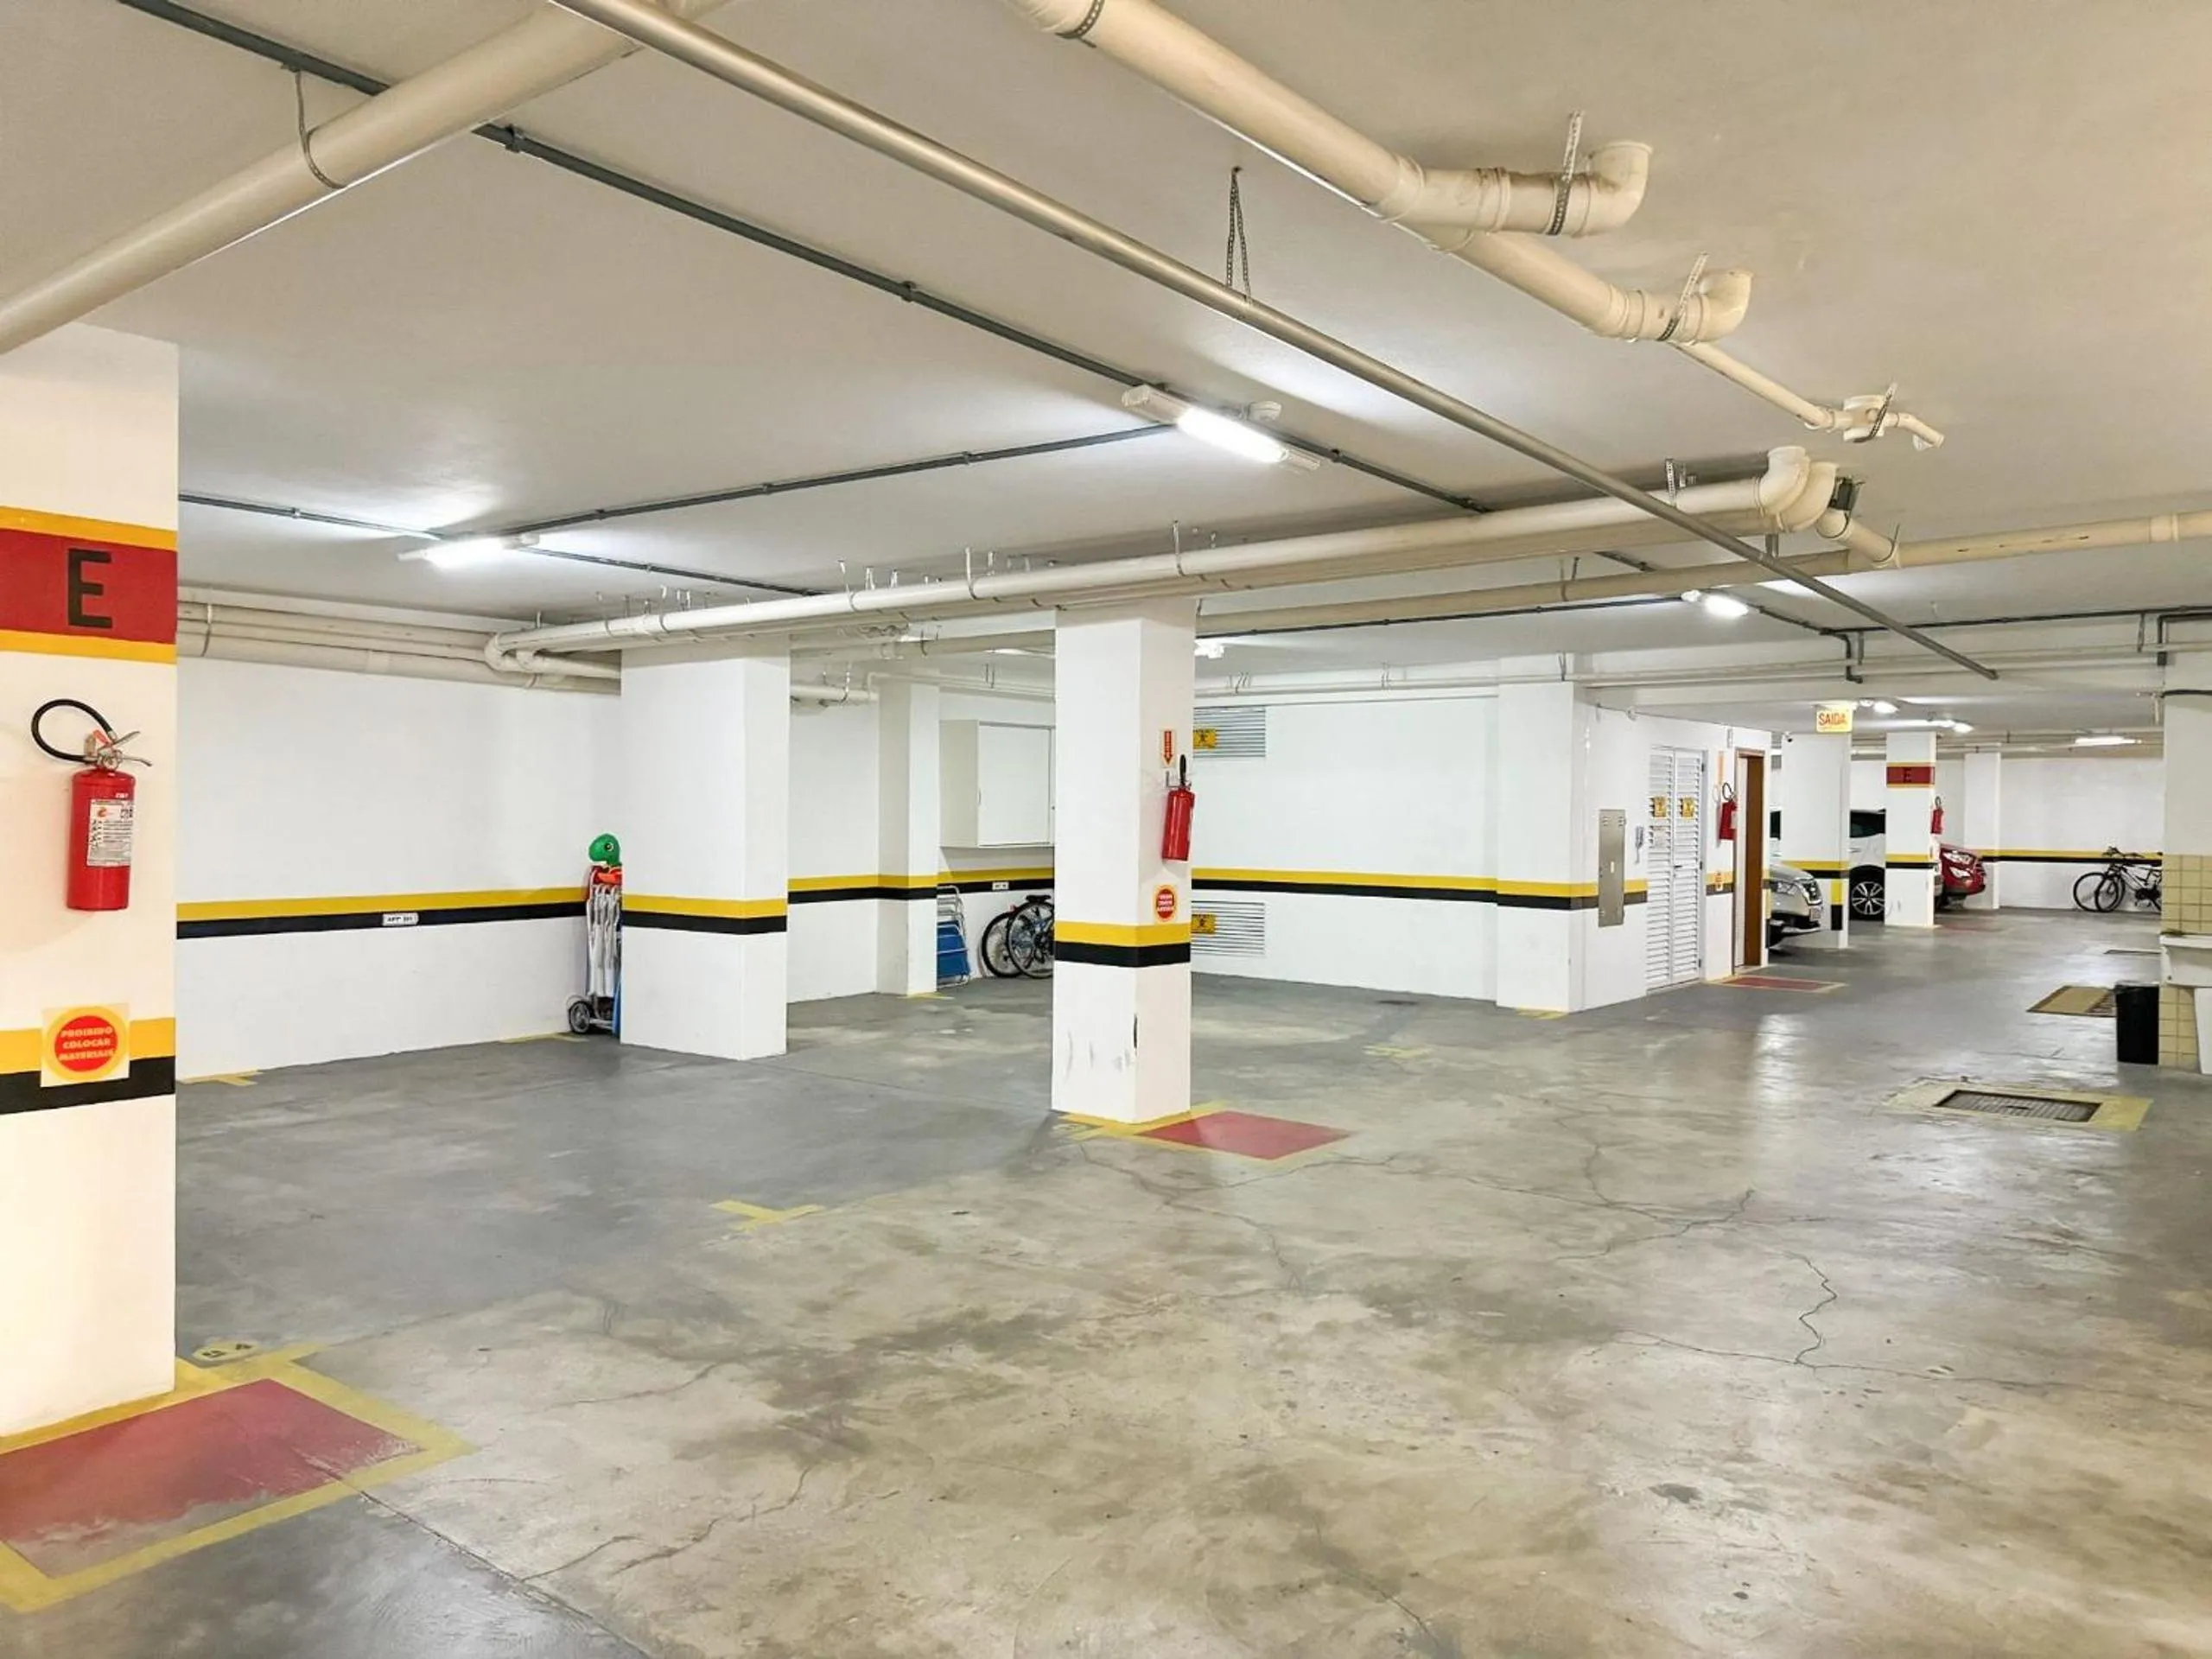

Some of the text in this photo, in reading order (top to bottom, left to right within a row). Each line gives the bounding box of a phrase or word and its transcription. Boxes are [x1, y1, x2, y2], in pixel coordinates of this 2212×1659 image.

[67, 548, 113, 629] E
[60, 1027, 113, 1038] PROIBIDO
[62, 1038, 111, 1049] COLOCAR
